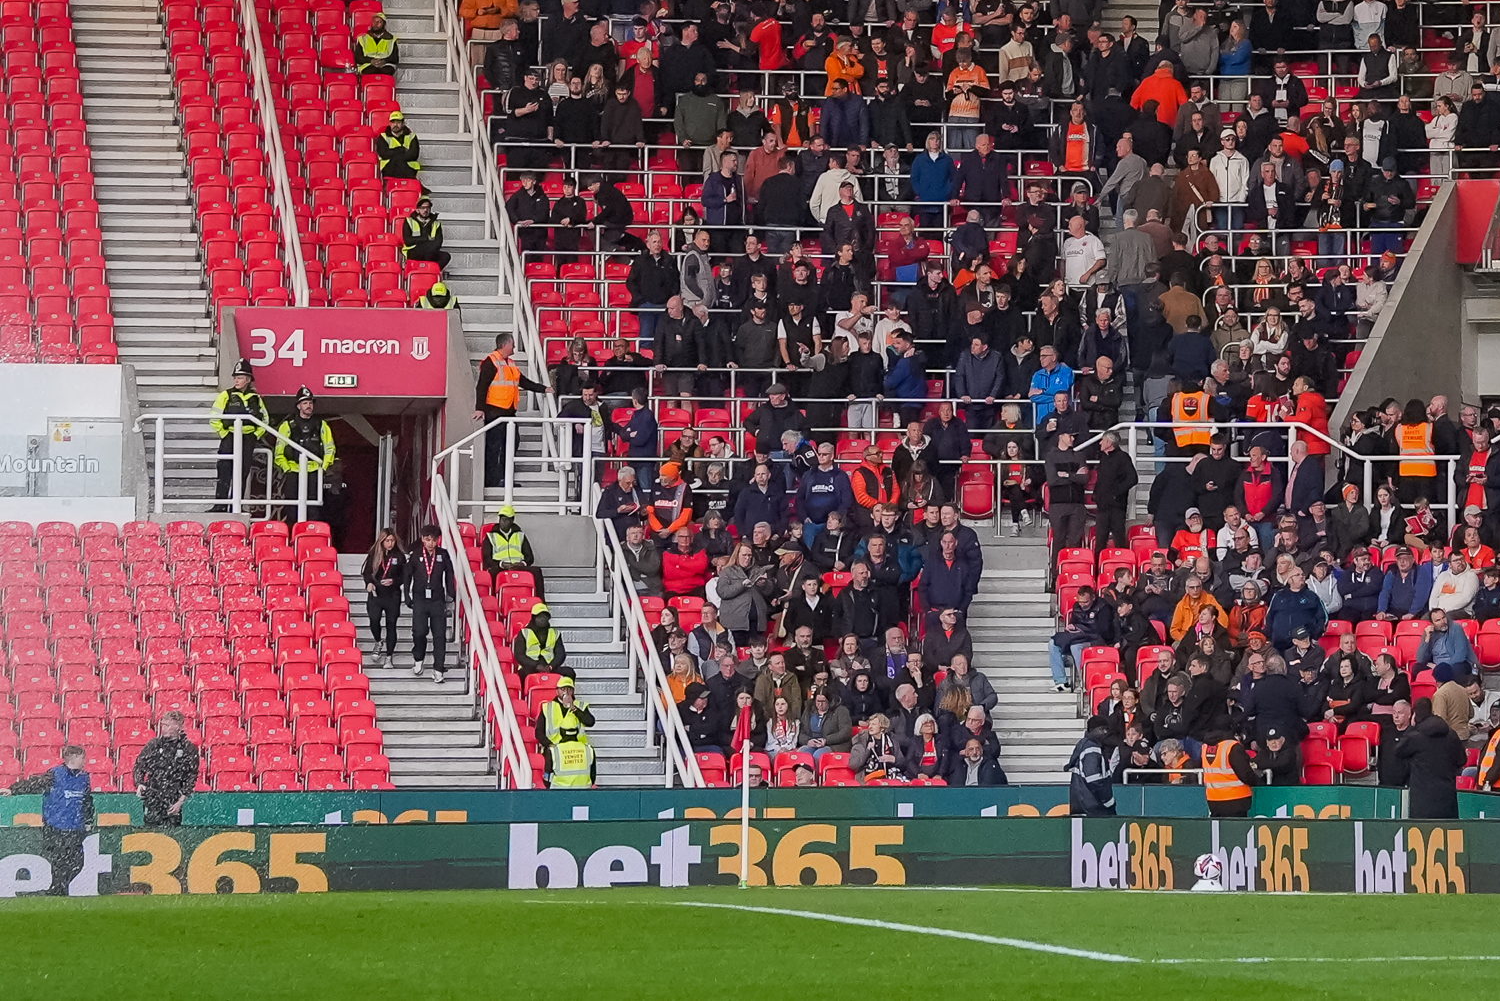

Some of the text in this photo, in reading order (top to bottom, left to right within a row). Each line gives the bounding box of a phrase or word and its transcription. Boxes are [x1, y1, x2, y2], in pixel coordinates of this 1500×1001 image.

[249, 328, 400, 367] 34 macron
[0, 454, 101, 474] Mountain
[0, 832, 328, 896] et365
[509, 824, 906, 888] bet365
[1071, 818, 1174, 890] bet365
[1211, 820, 1310, 892] bet365
[1354, 822, 1466, 894] bet365
